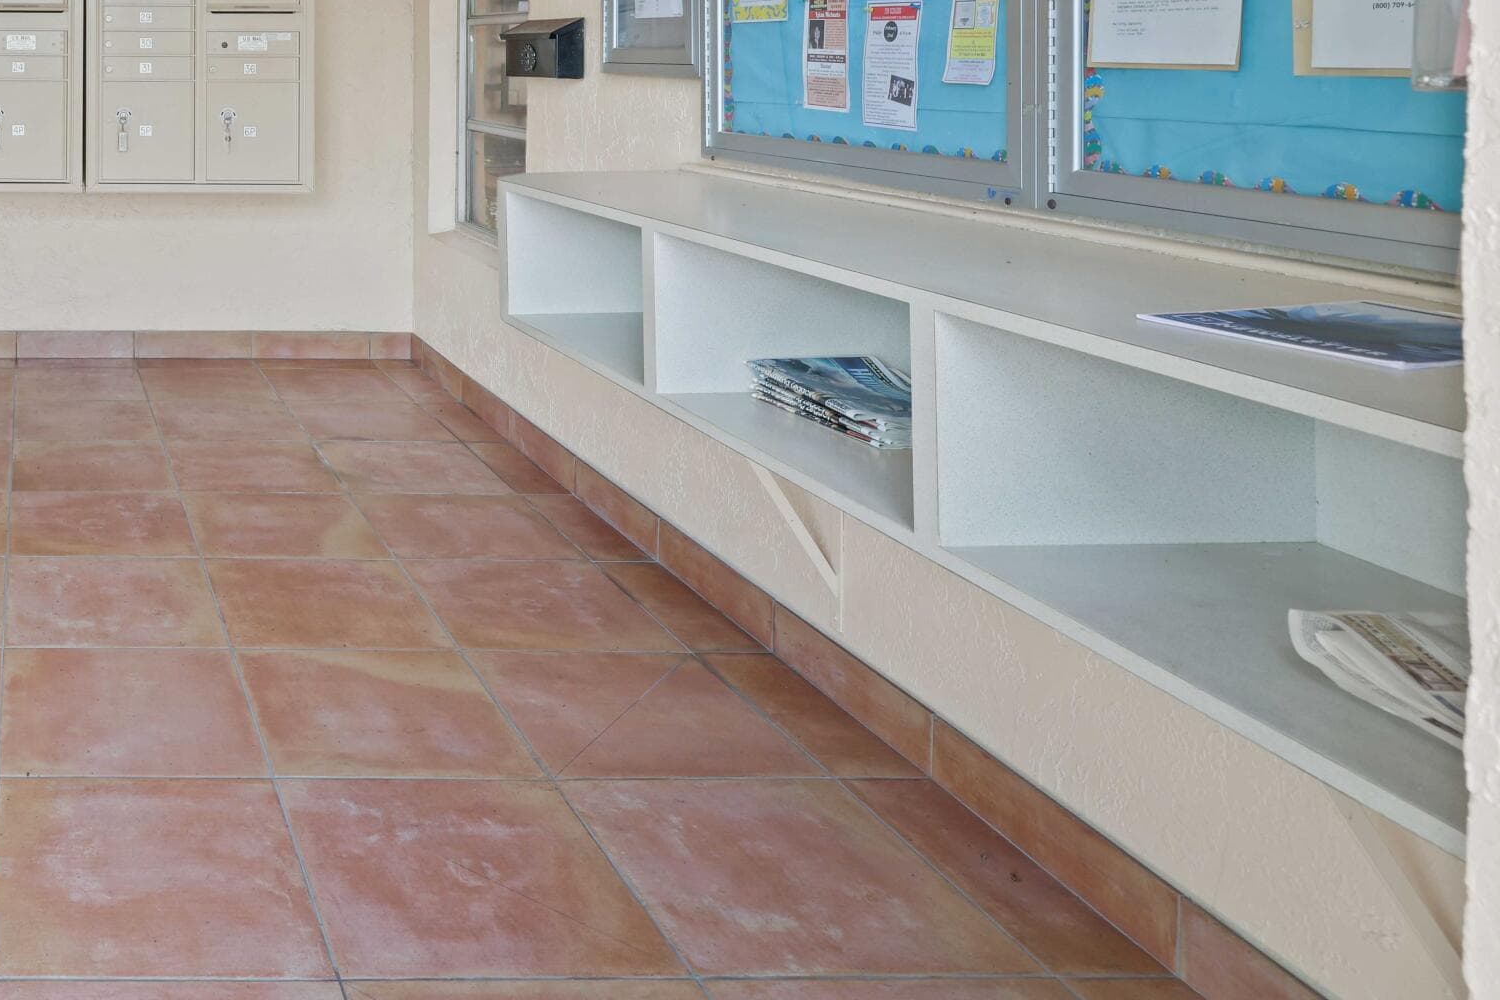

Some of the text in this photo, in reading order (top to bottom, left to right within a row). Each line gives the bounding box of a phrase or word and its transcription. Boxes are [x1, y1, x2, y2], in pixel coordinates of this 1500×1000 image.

[1372, 2, 1390, 10] (800)
[14, 63, 23, 71] 24
[142, 64, 150, 72] 31
[246, 65, 255, 73] 36
[14, 126, 23, 134] 4P
[245, 128, 254, 136] 6P
